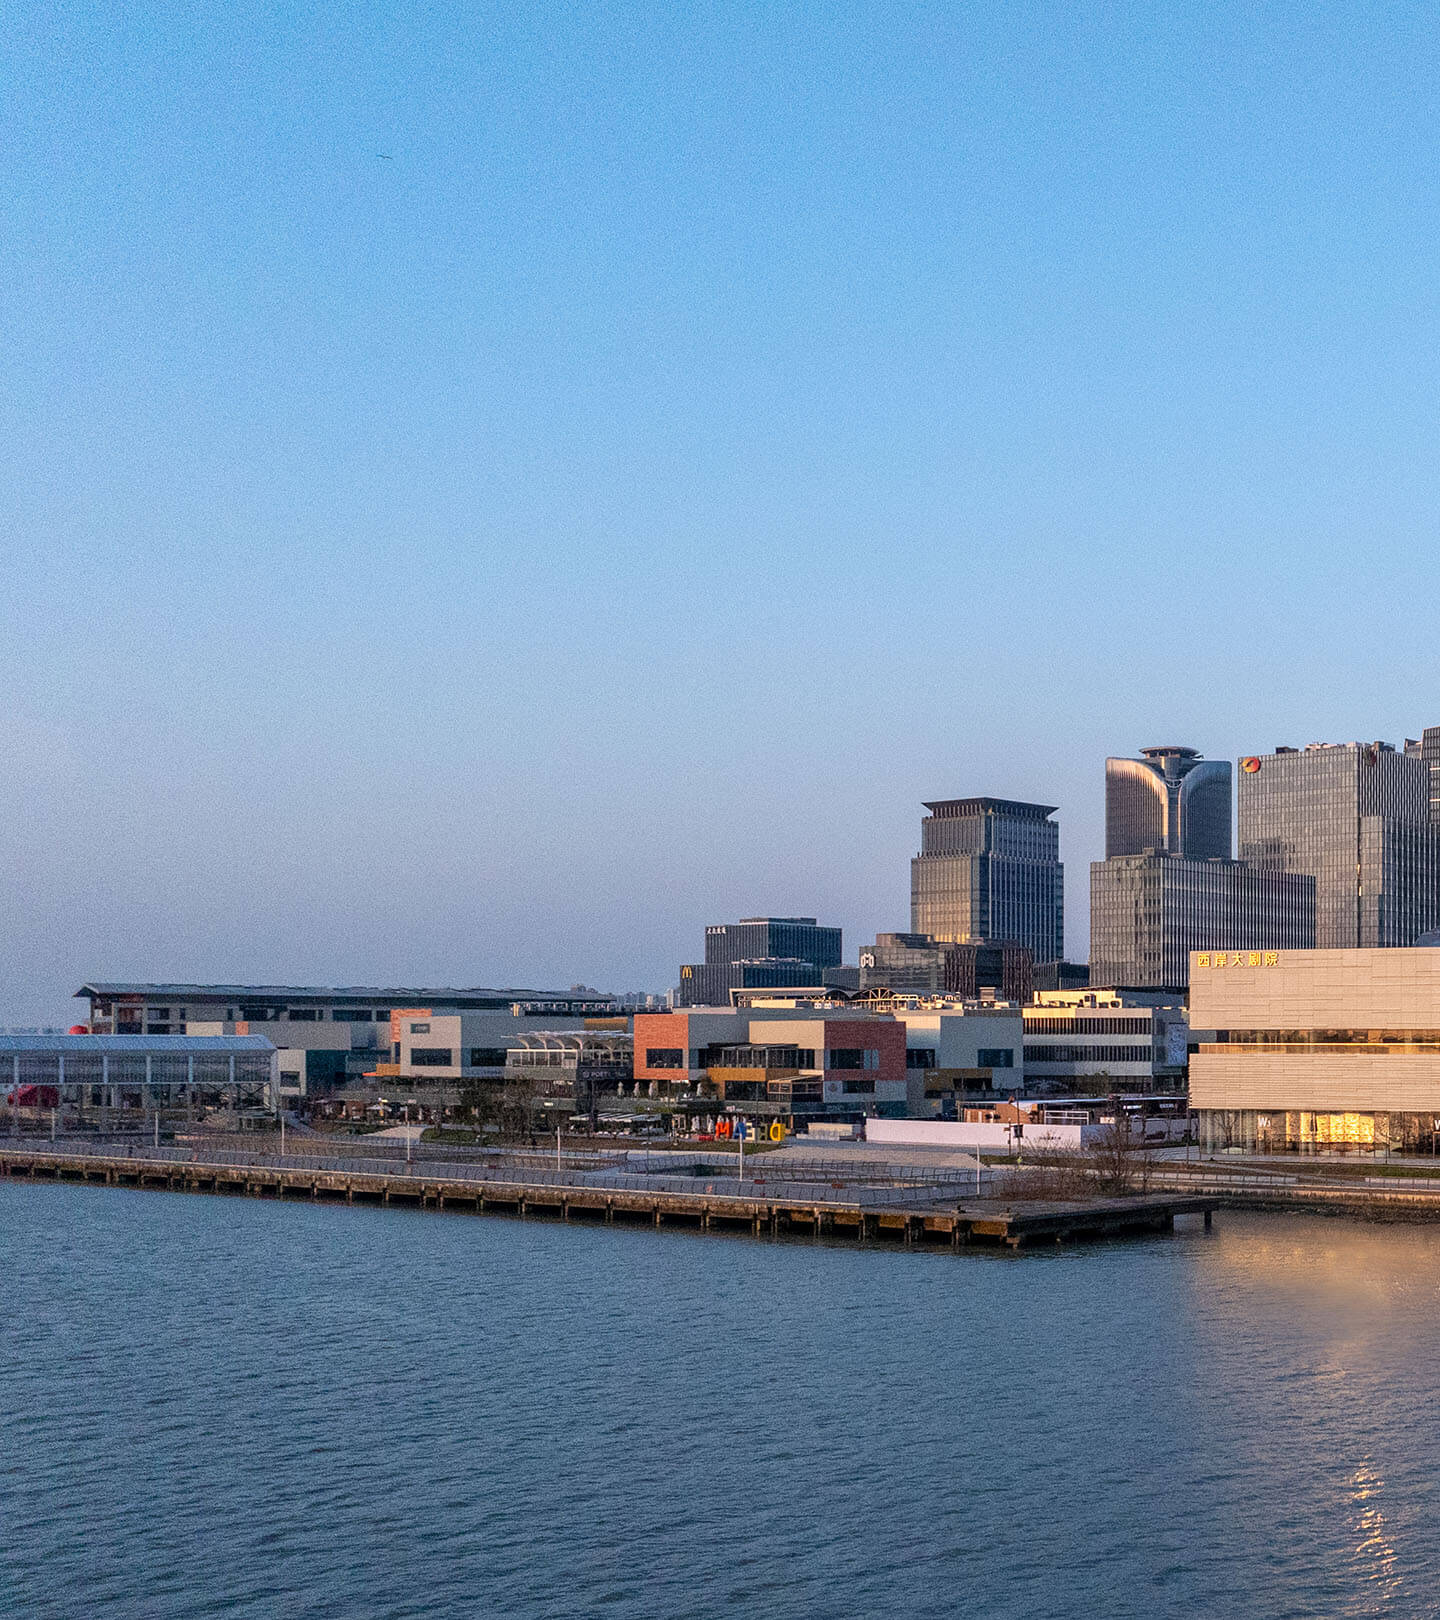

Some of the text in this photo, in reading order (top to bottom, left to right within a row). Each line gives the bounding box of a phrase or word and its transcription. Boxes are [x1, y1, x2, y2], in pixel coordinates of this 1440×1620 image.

[1197, 952, 1279, 968] 西岸大剧院
